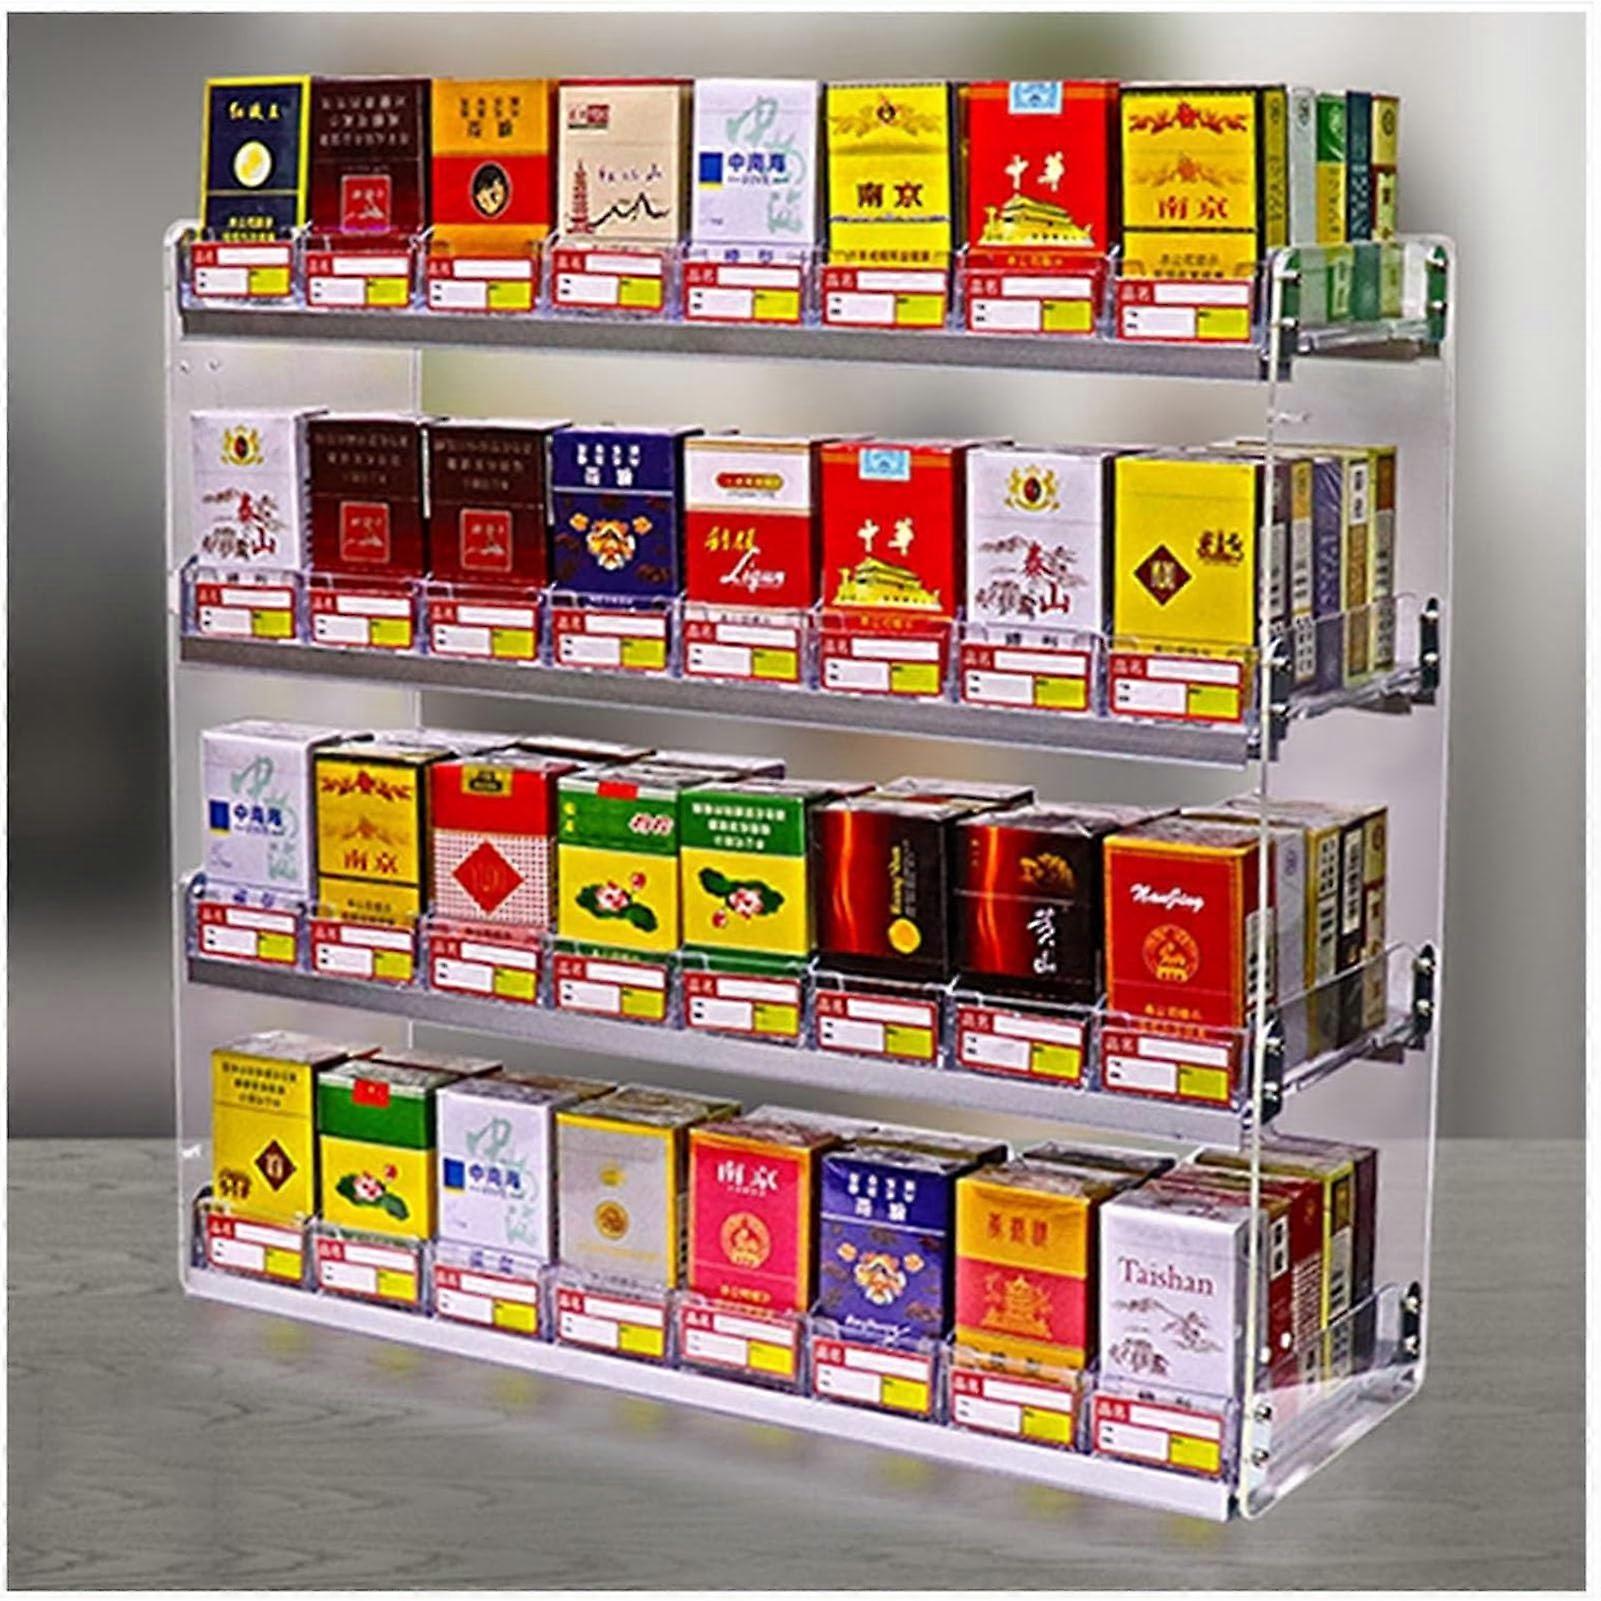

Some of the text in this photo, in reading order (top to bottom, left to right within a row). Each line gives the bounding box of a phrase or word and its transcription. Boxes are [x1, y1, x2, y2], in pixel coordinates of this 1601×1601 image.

[728, 152, 786, 173] 中南海
[1004, 151, 1065, 192] 中华
[856, 181, 924, 209] 南京
[1157, 195, 1229, 219] 南京
[857, 516, 914, 556] 中华
[1024, 541, 1071, 613] 泰山
[344, 848, 399, 874] 南京
[717, 1159, 780, 1191] 南京
[1117, 1256, 1215, 1296] Taishan
